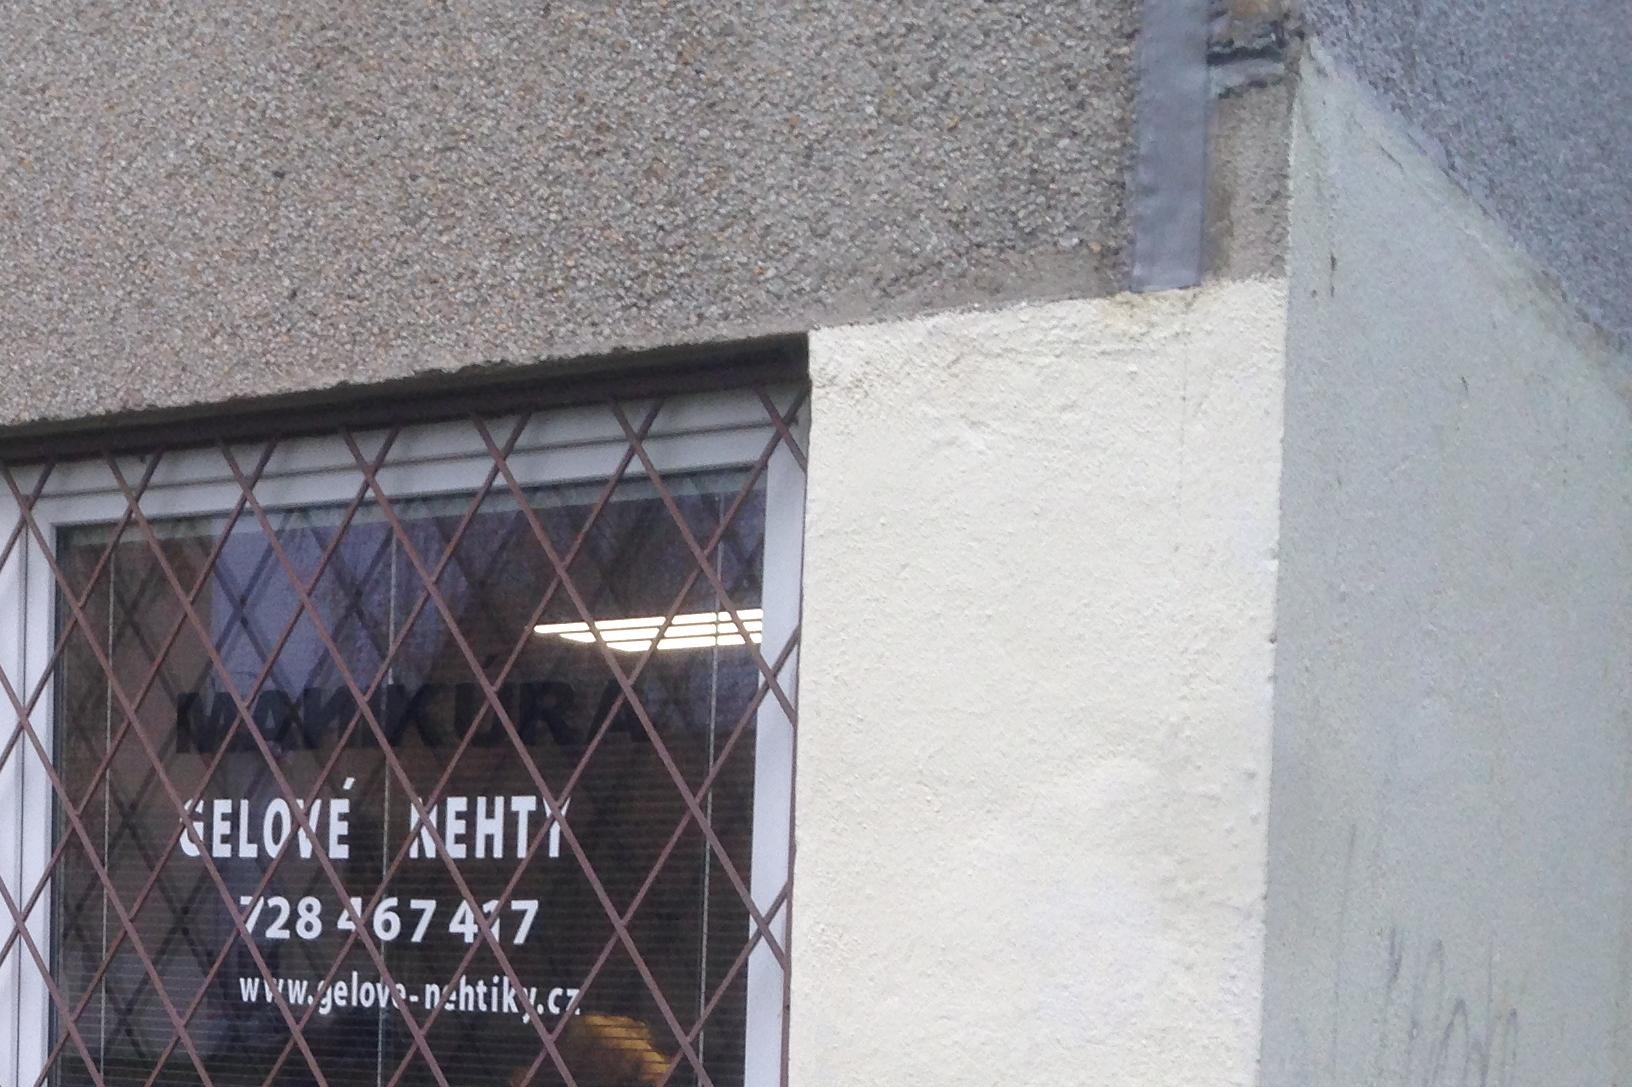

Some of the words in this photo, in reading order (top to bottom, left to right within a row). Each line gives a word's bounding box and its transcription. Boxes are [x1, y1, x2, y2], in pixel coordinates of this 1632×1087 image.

[179, 777, 355, 860] GELOVÉ
[410, 796, 571, 859] NEHTY
[240, 896, 322, 940] 728
[337, 897, 436, 943] 467
[449, 899, 539, 944] 417
